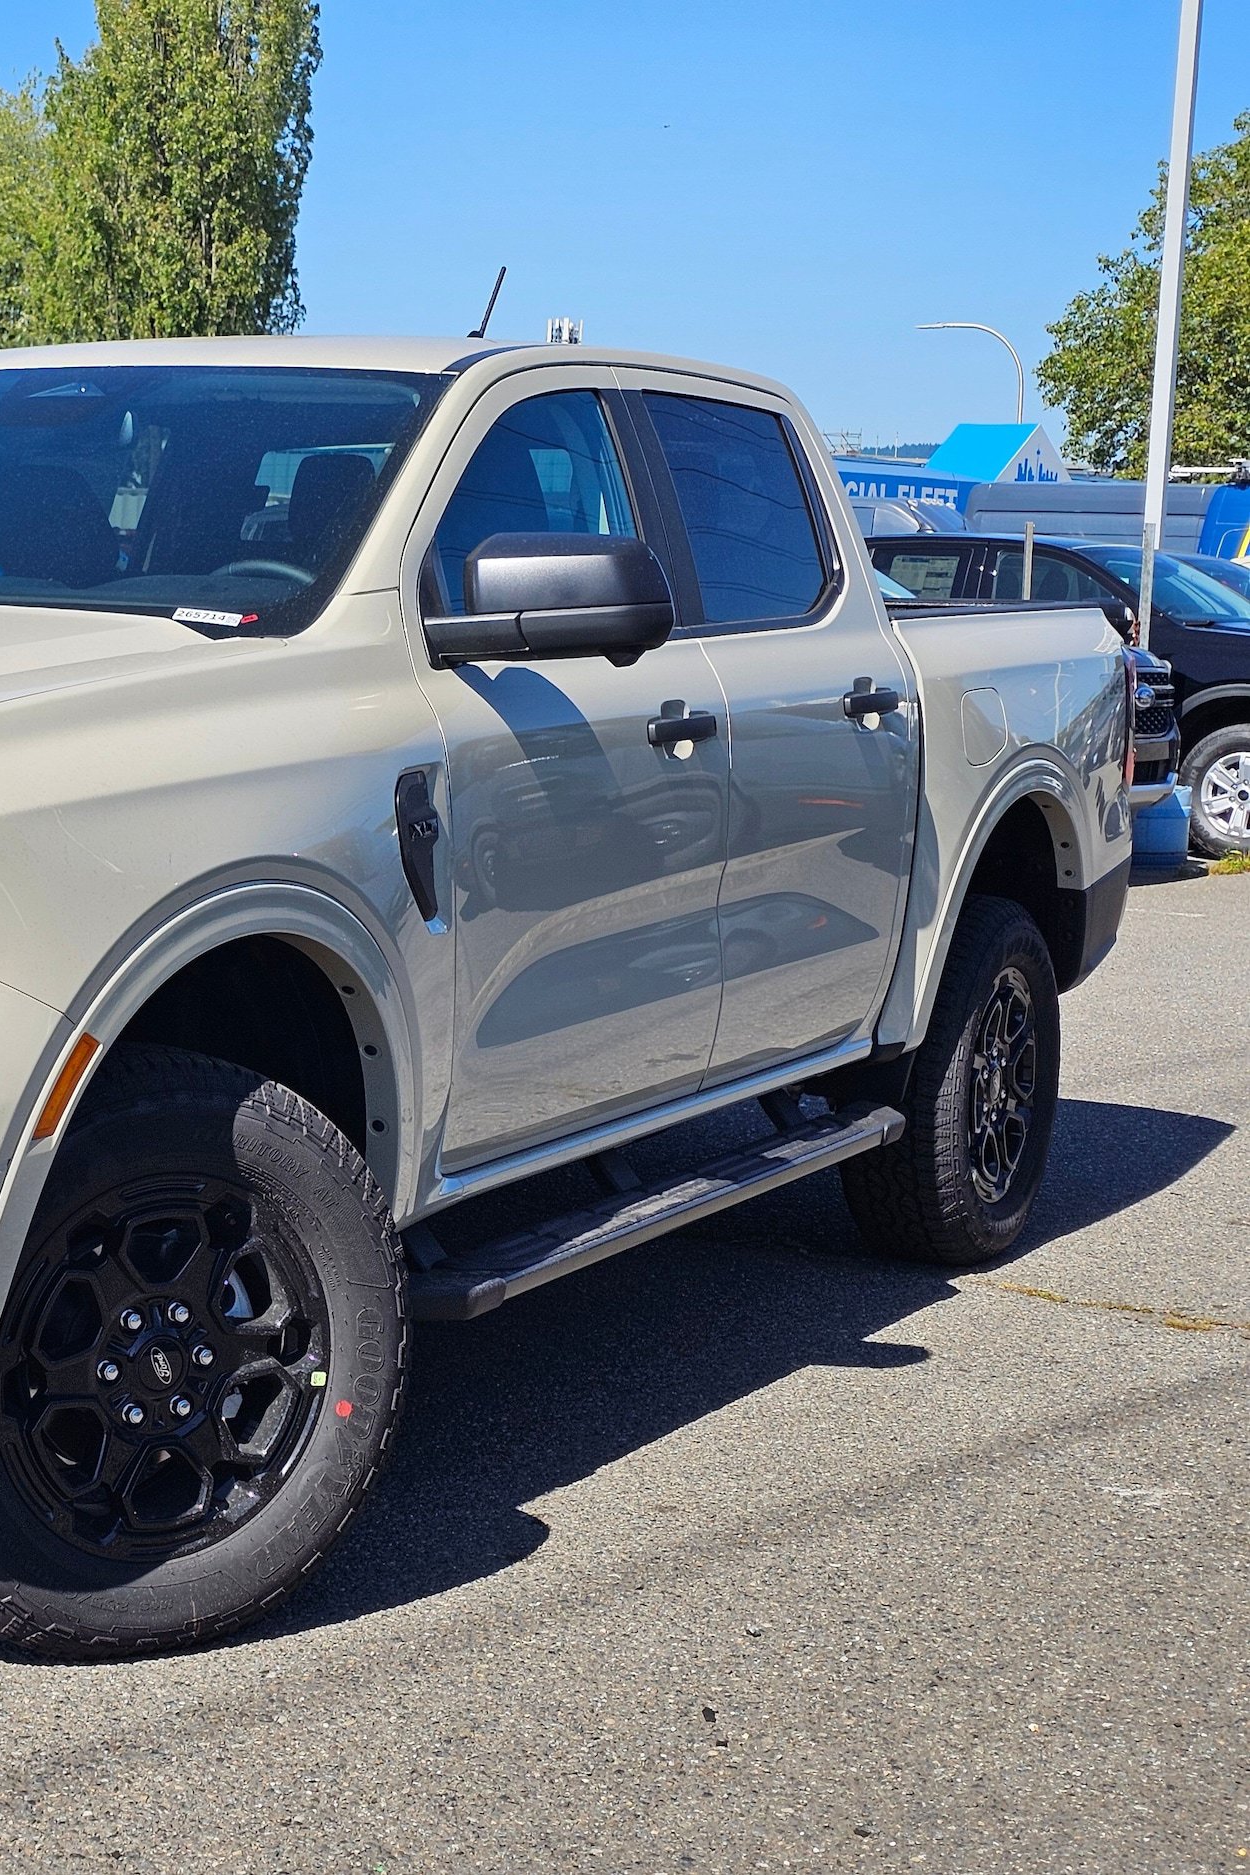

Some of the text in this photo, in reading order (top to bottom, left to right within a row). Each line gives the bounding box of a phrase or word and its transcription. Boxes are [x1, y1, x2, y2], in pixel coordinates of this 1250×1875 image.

[898, 484, 958, 503] FLEET
[176, 609, 227, 622] 265714
[154, 1352, 170, 1377] Ford
[250, 1307, 385, 1580] GOODYEAR
